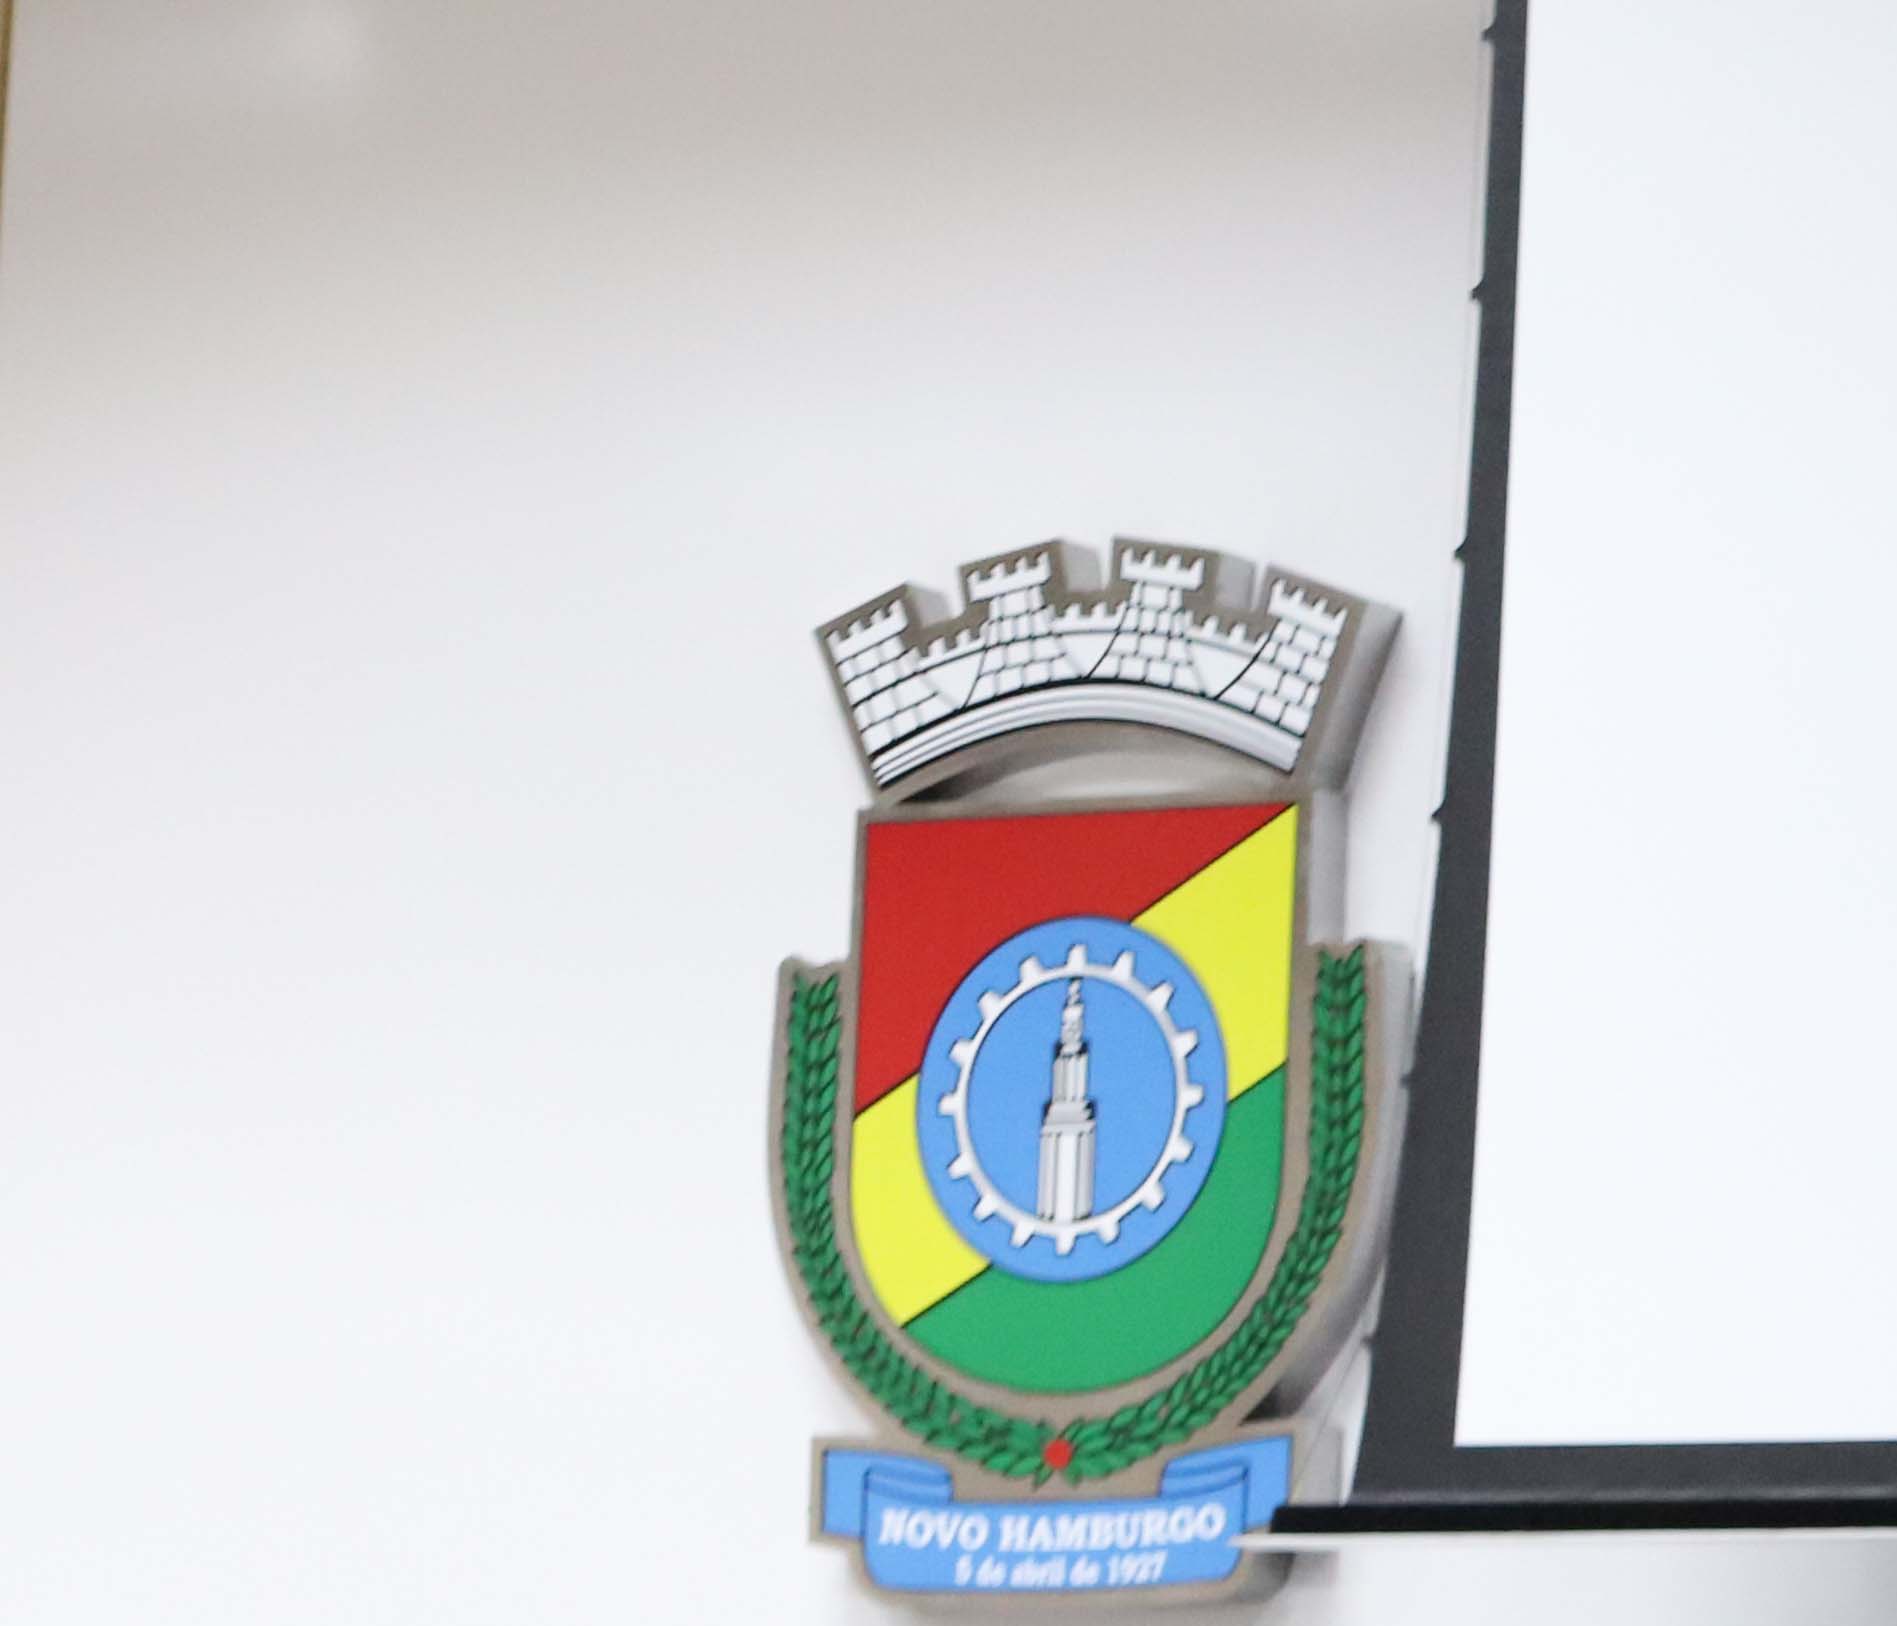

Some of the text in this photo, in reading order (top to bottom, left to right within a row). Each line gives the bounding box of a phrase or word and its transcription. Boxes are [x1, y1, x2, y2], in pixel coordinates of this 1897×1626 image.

[879, 1502, 1228, 1552] NOVO HAMBURGO
[975, 1556, 1006, 1587] de
[1010, 1555, 1067, 1588] abril
[1069, 1555, 1100, 1587] de
